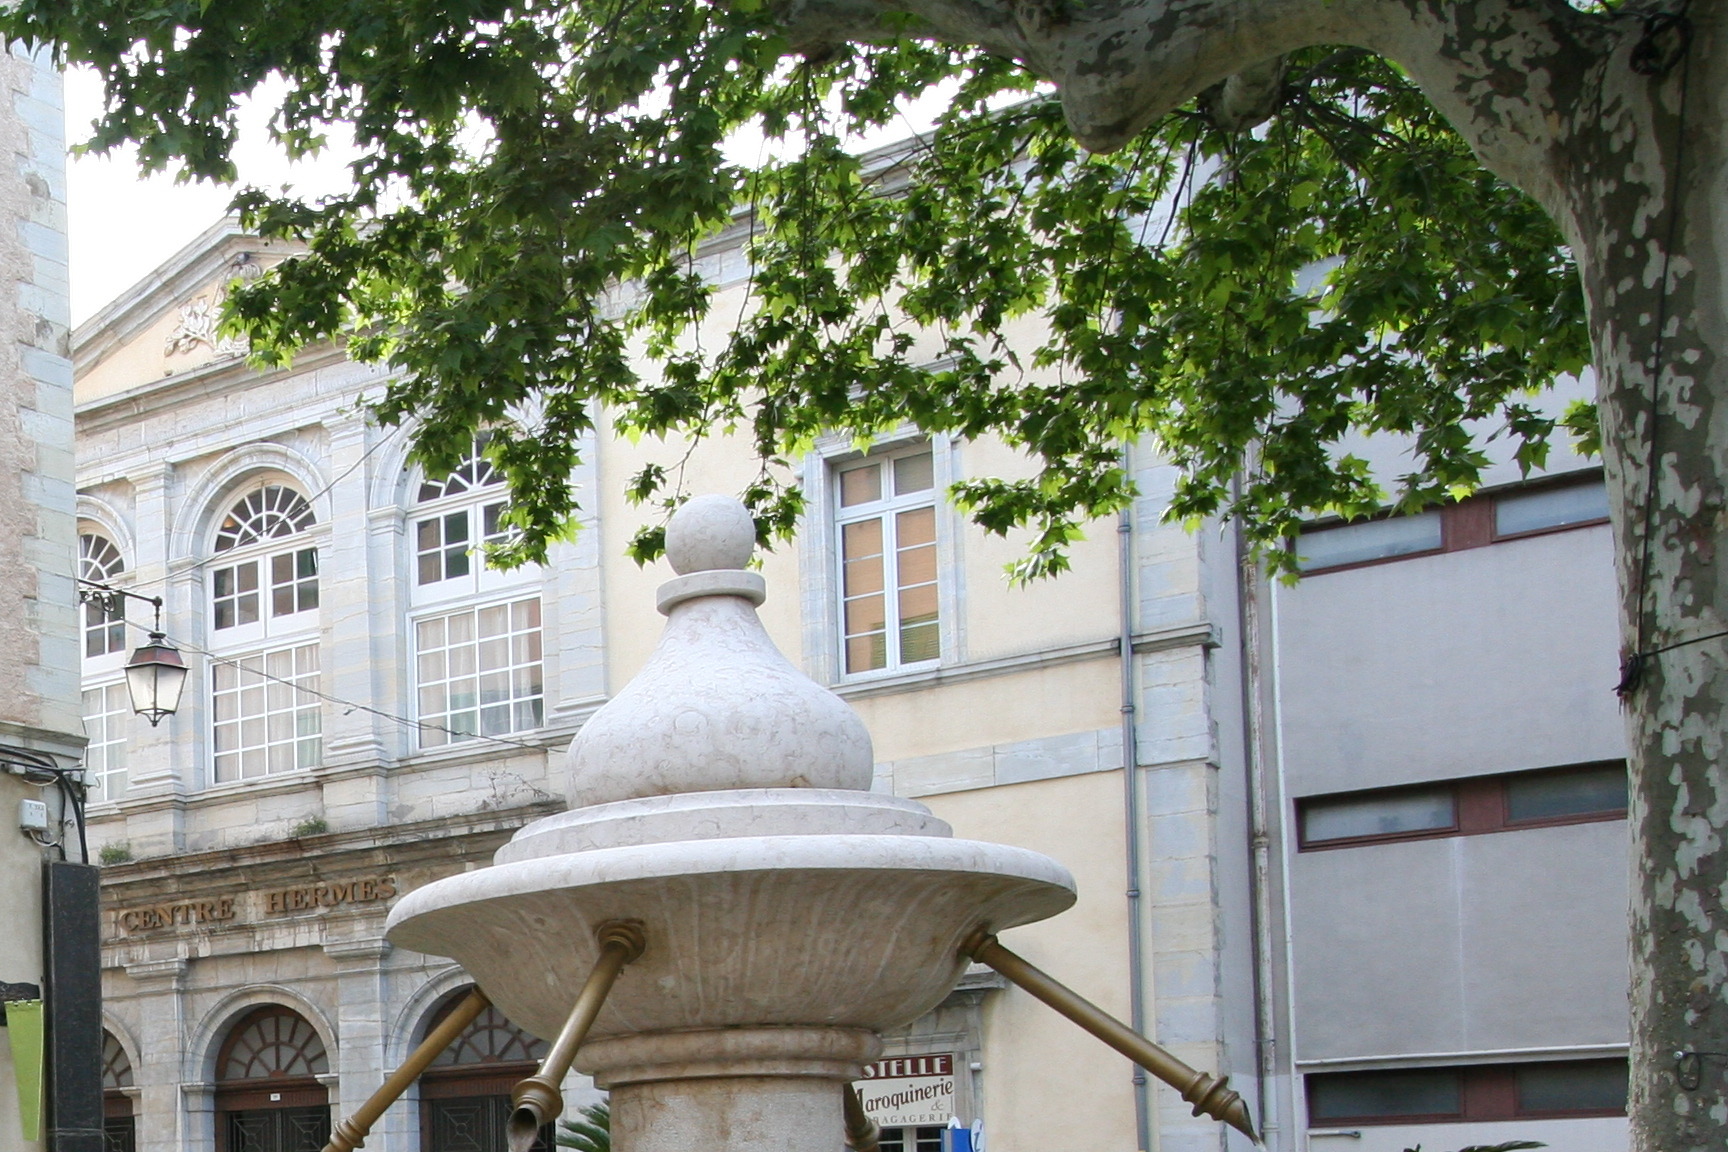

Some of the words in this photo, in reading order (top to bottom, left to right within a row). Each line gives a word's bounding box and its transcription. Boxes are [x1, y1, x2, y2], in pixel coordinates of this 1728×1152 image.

[120, 898, 236, 932] CENTRE
[265, 877, 397, 915] HERMES
[930, 1099, 944, 1111] &
